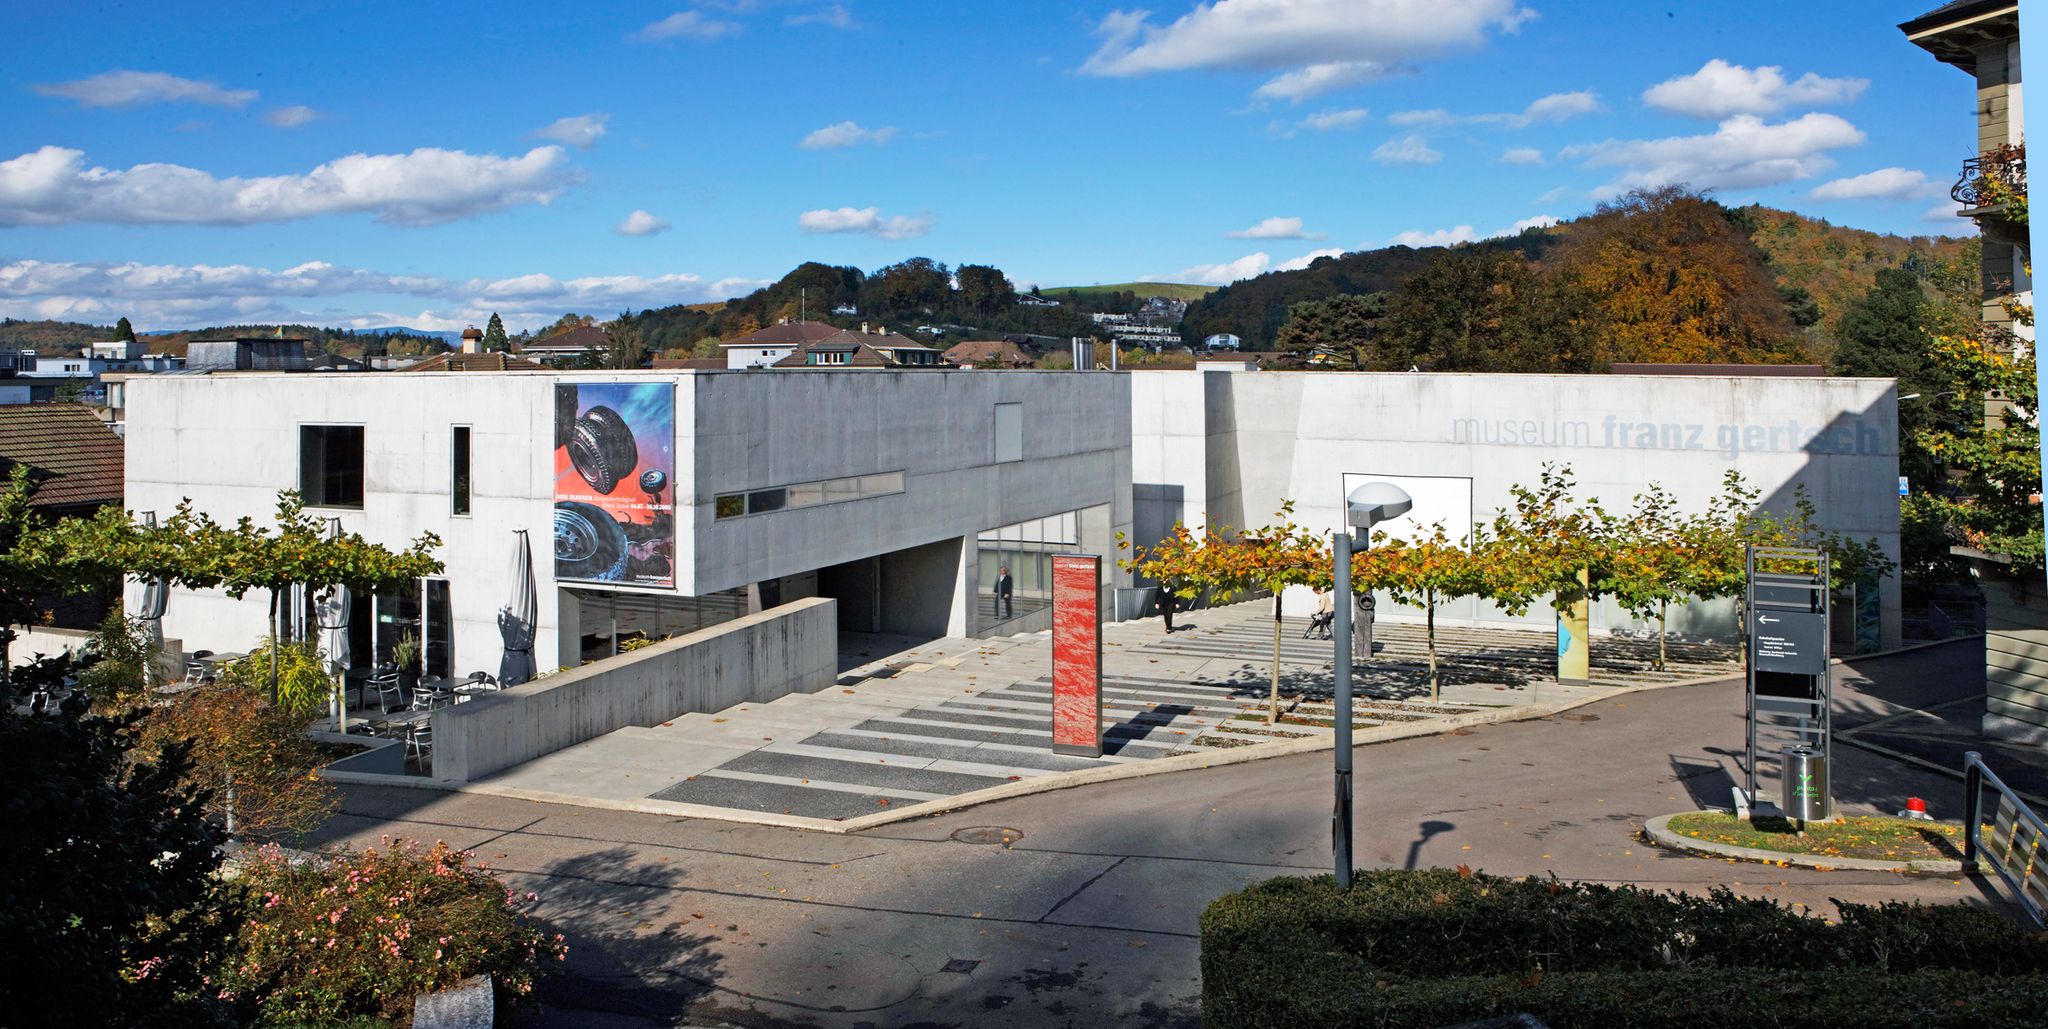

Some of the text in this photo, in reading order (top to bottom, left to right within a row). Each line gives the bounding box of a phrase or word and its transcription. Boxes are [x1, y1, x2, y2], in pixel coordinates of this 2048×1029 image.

[1452, 414, 1880, 461] museum franz gertsch
